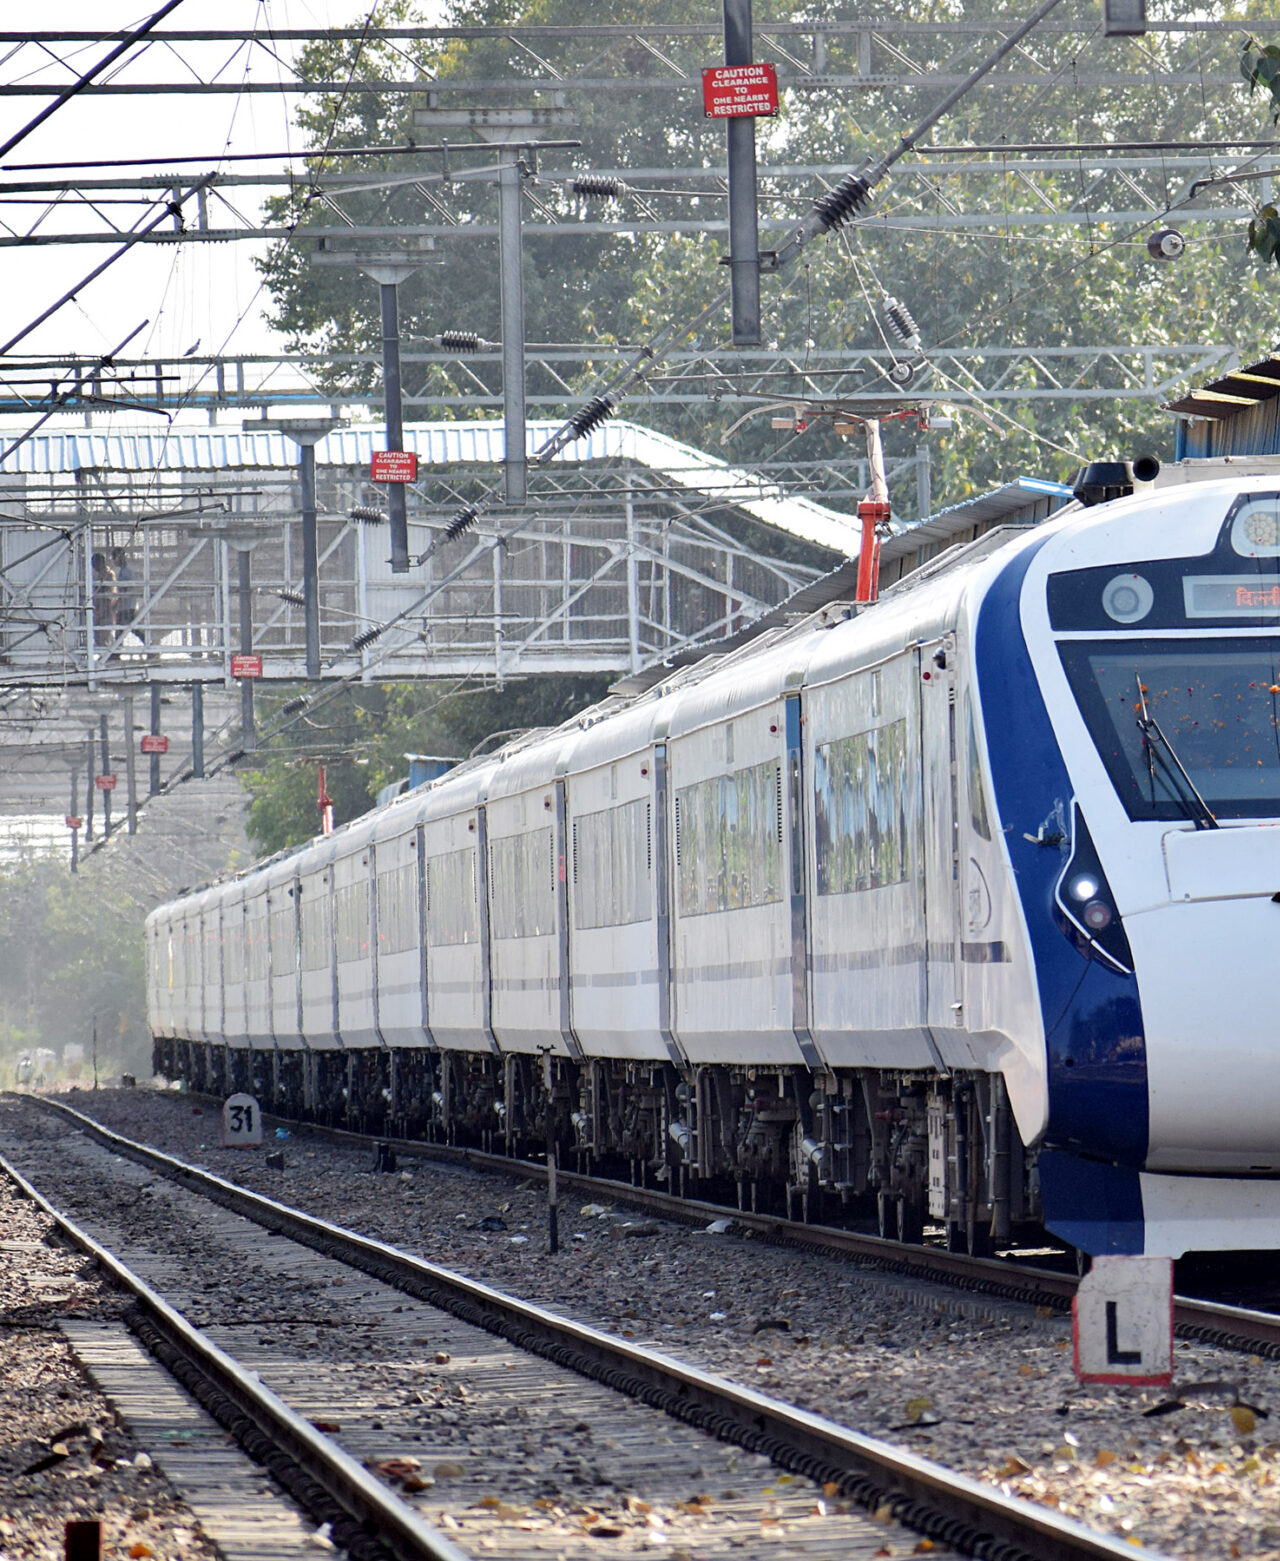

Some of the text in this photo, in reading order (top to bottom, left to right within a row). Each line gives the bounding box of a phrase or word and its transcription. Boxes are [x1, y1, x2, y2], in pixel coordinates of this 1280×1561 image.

[715, 67, 763, 78] CAUTION
[712, 77, 768, 87] CLEARANCE
[734, 94, 769, 102] NEARBY
[714, 102, 771, 115] RESTRICTED
[1236, 585, 1280, 607] दिल्ली
[229, 1105, 253, 1133] 31
[1106, 1301, 1142, 1365] L
